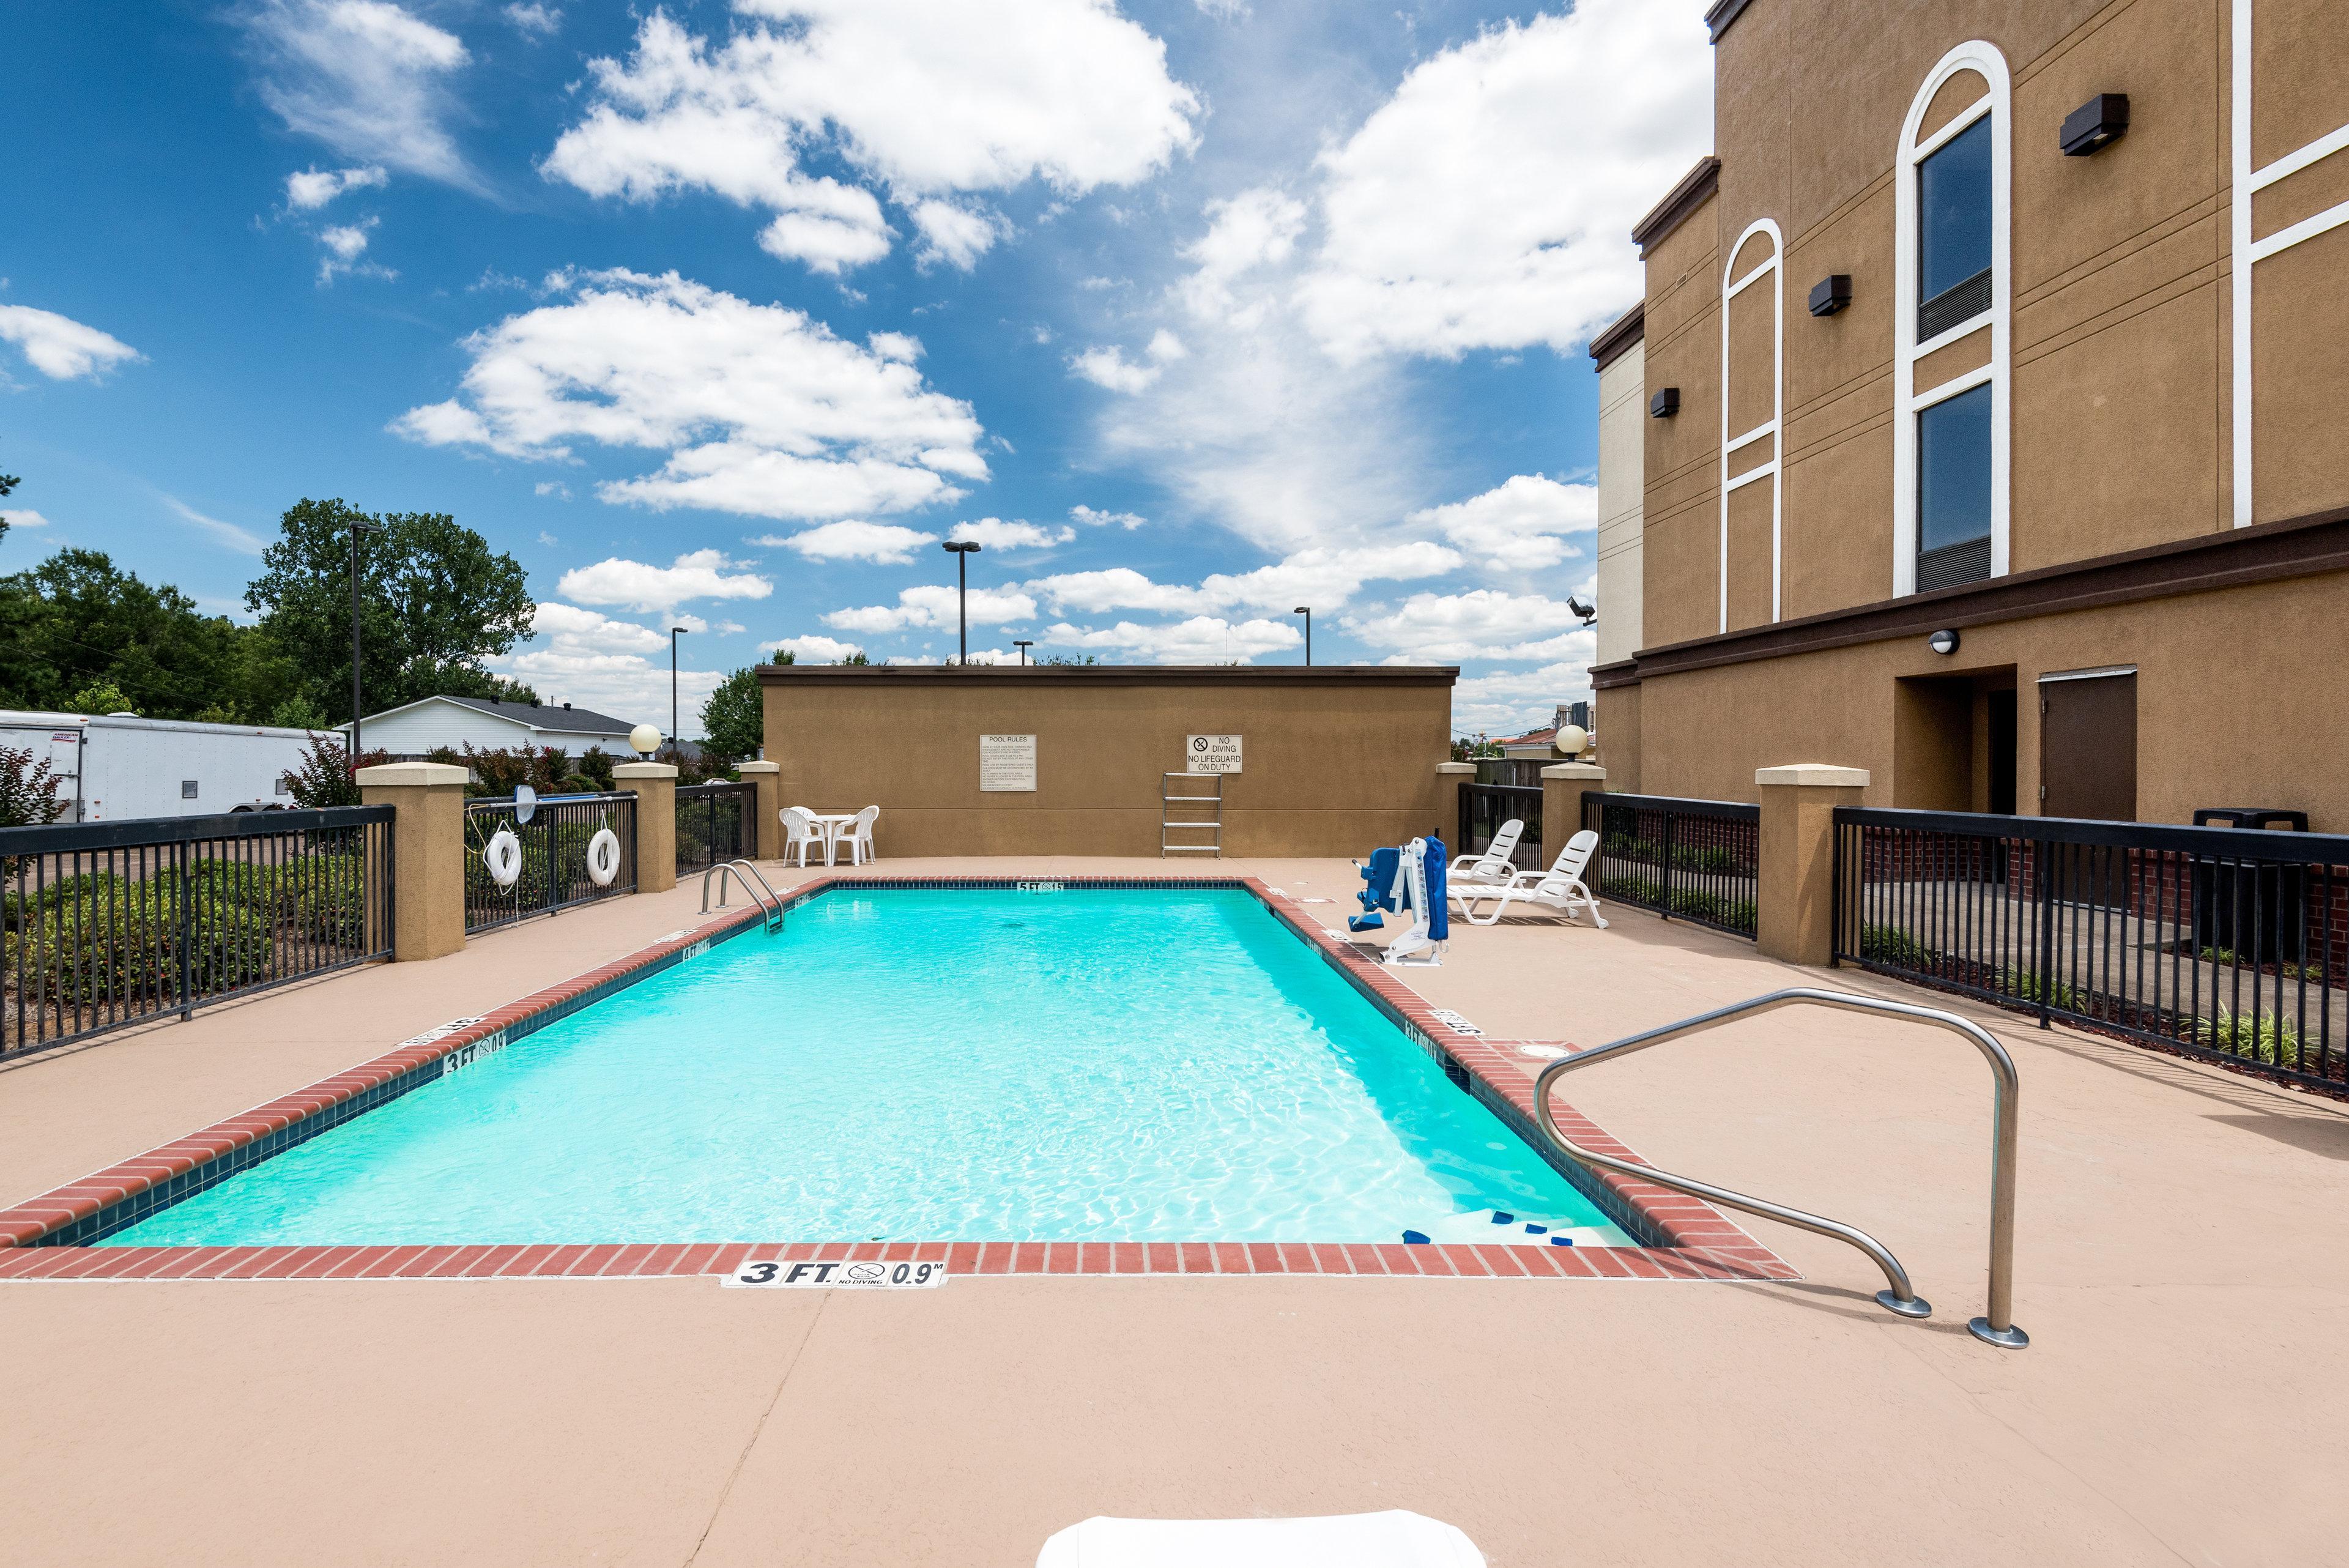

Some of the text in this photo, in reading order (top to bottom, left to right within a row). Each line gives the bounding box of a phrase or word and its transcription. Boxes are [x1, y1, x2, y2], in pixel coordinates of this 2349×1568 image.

[447, 1053, 458, 1073] 3
[741, 1263, 779, 1283] 3
[785, 1264, 840, 1283] FT.
